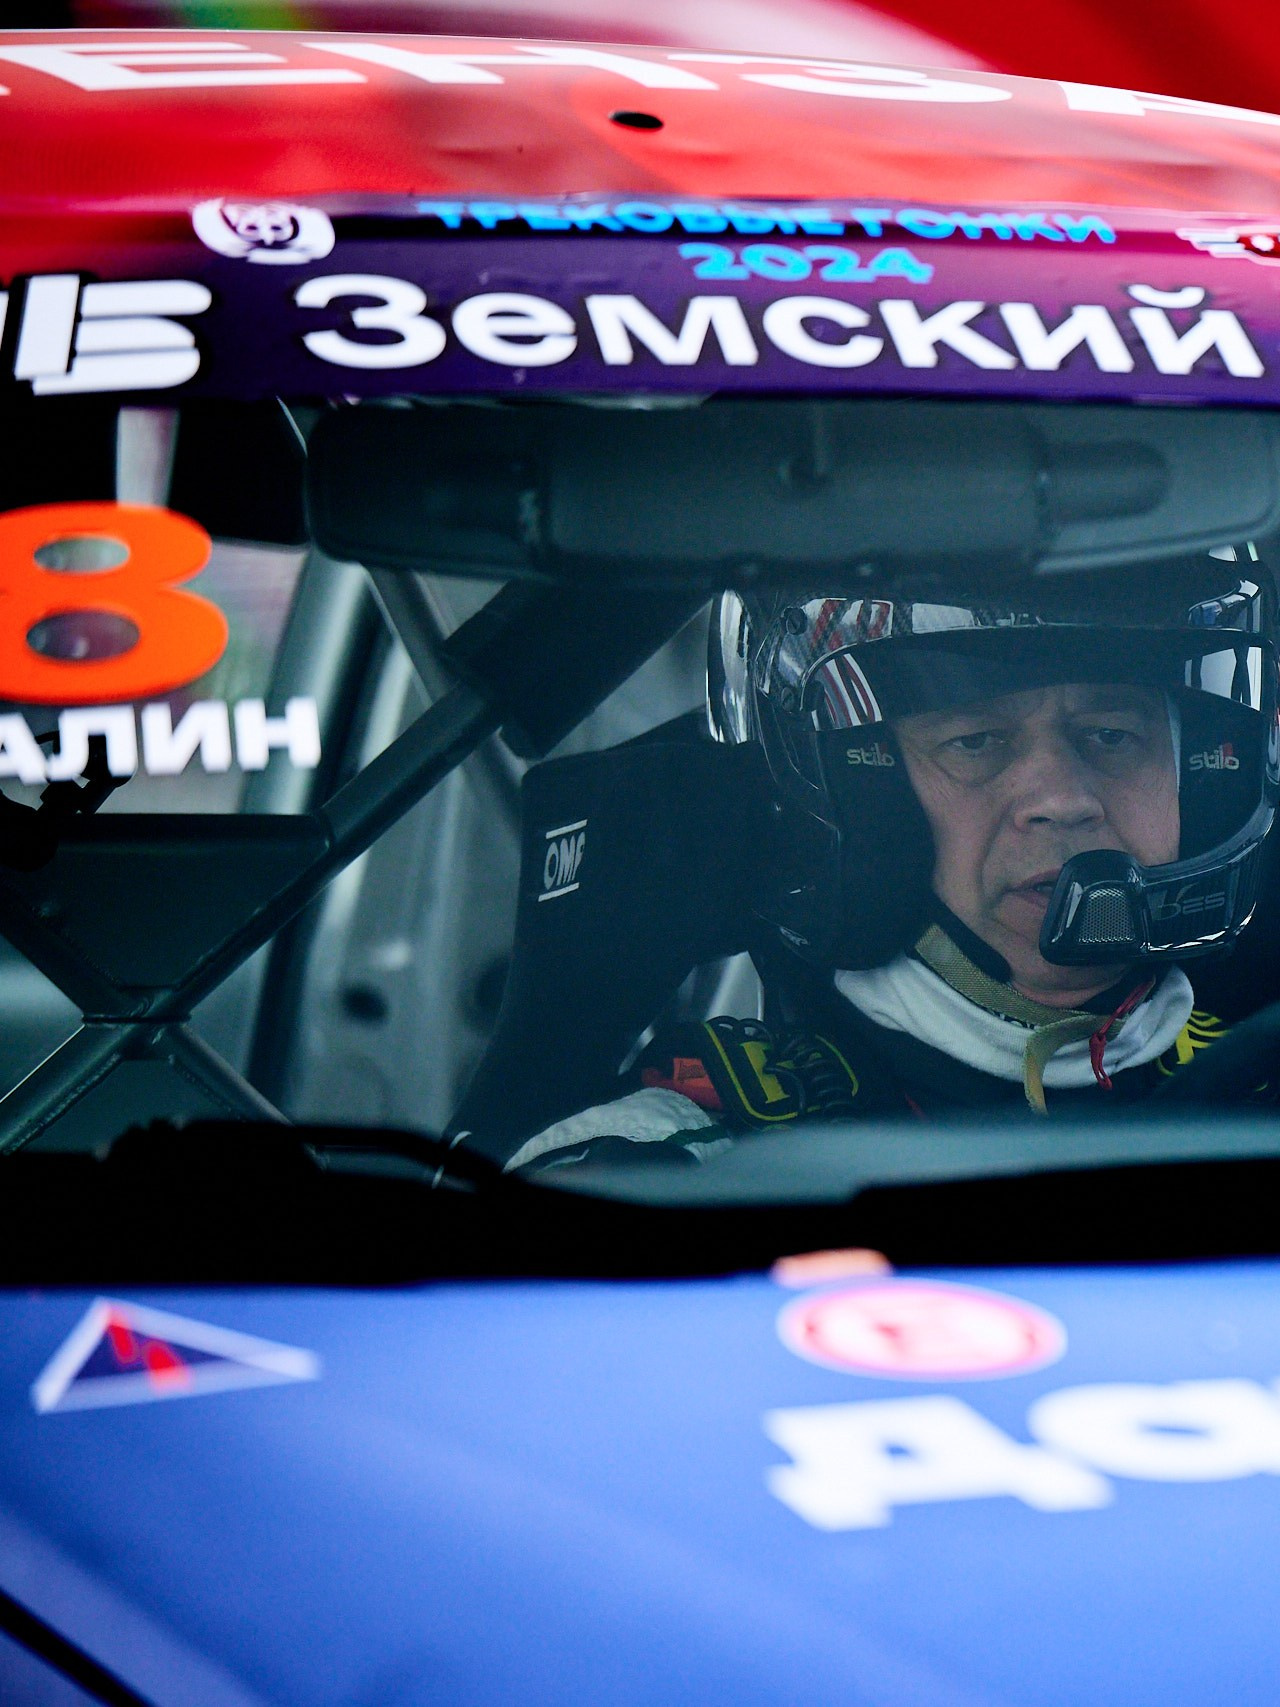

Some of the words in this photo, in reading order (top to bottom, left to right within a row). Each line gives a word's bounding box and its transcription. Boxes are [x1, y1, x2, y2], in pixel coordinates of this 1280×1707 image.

[417, 200, 846, 236] ТРЕКОВЫЕ
[850, 206, 1116, 244] ГОНКИ
[677, 242, 934, 284] 2024
[295, 273, 1265, 379] Земский
[0, 501, 229, 705] 8
[1189, 743, 1240, 771] stilo
[543, 831, 586, 891] OMP
